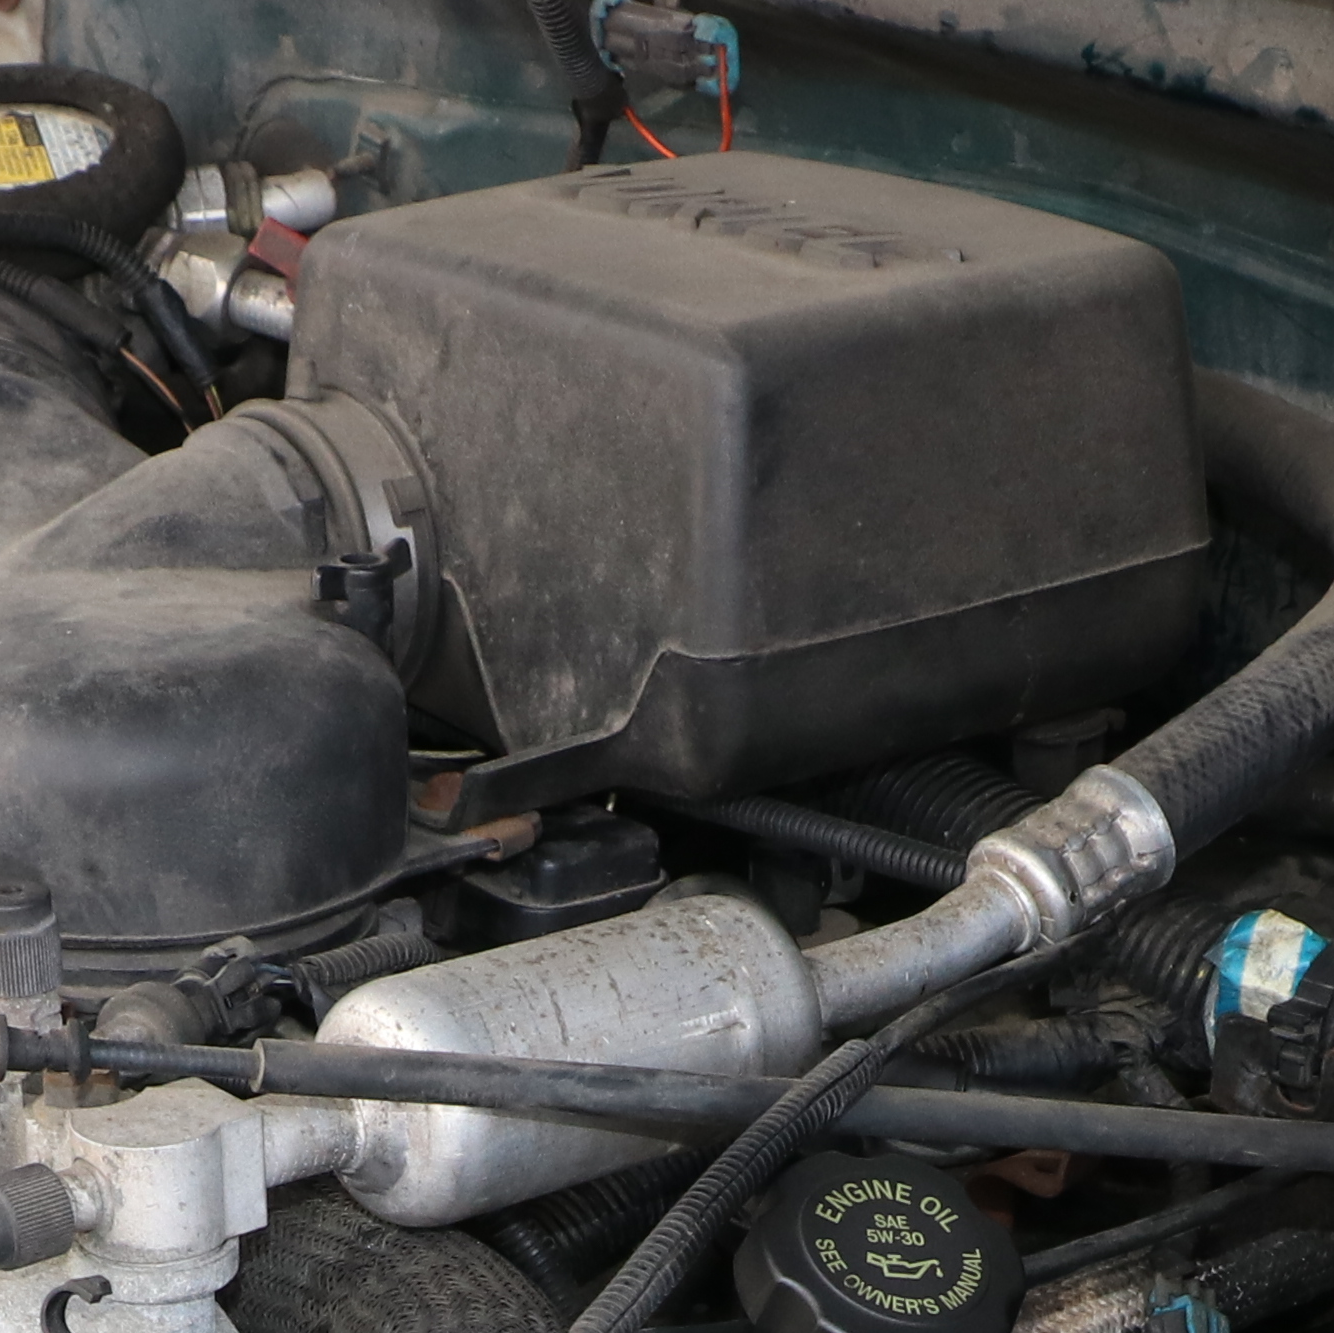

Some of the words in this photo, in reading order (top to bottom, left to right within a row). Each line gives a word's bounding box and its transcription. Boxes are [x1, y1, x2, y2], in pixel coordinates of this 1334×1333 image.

[815, 1179, 913, 1224] ENGINE
[920, 1196, 960, 1234] OIL
[873, 1213, 911, 1230] SAE
[866, 1229, 926, 1247] 5W-30
[815, 1238, 849, 1274] SEE
[843, 1273, 941, 1316] OWNER'S
[938, 1248, 984, 1311] MANUAL
